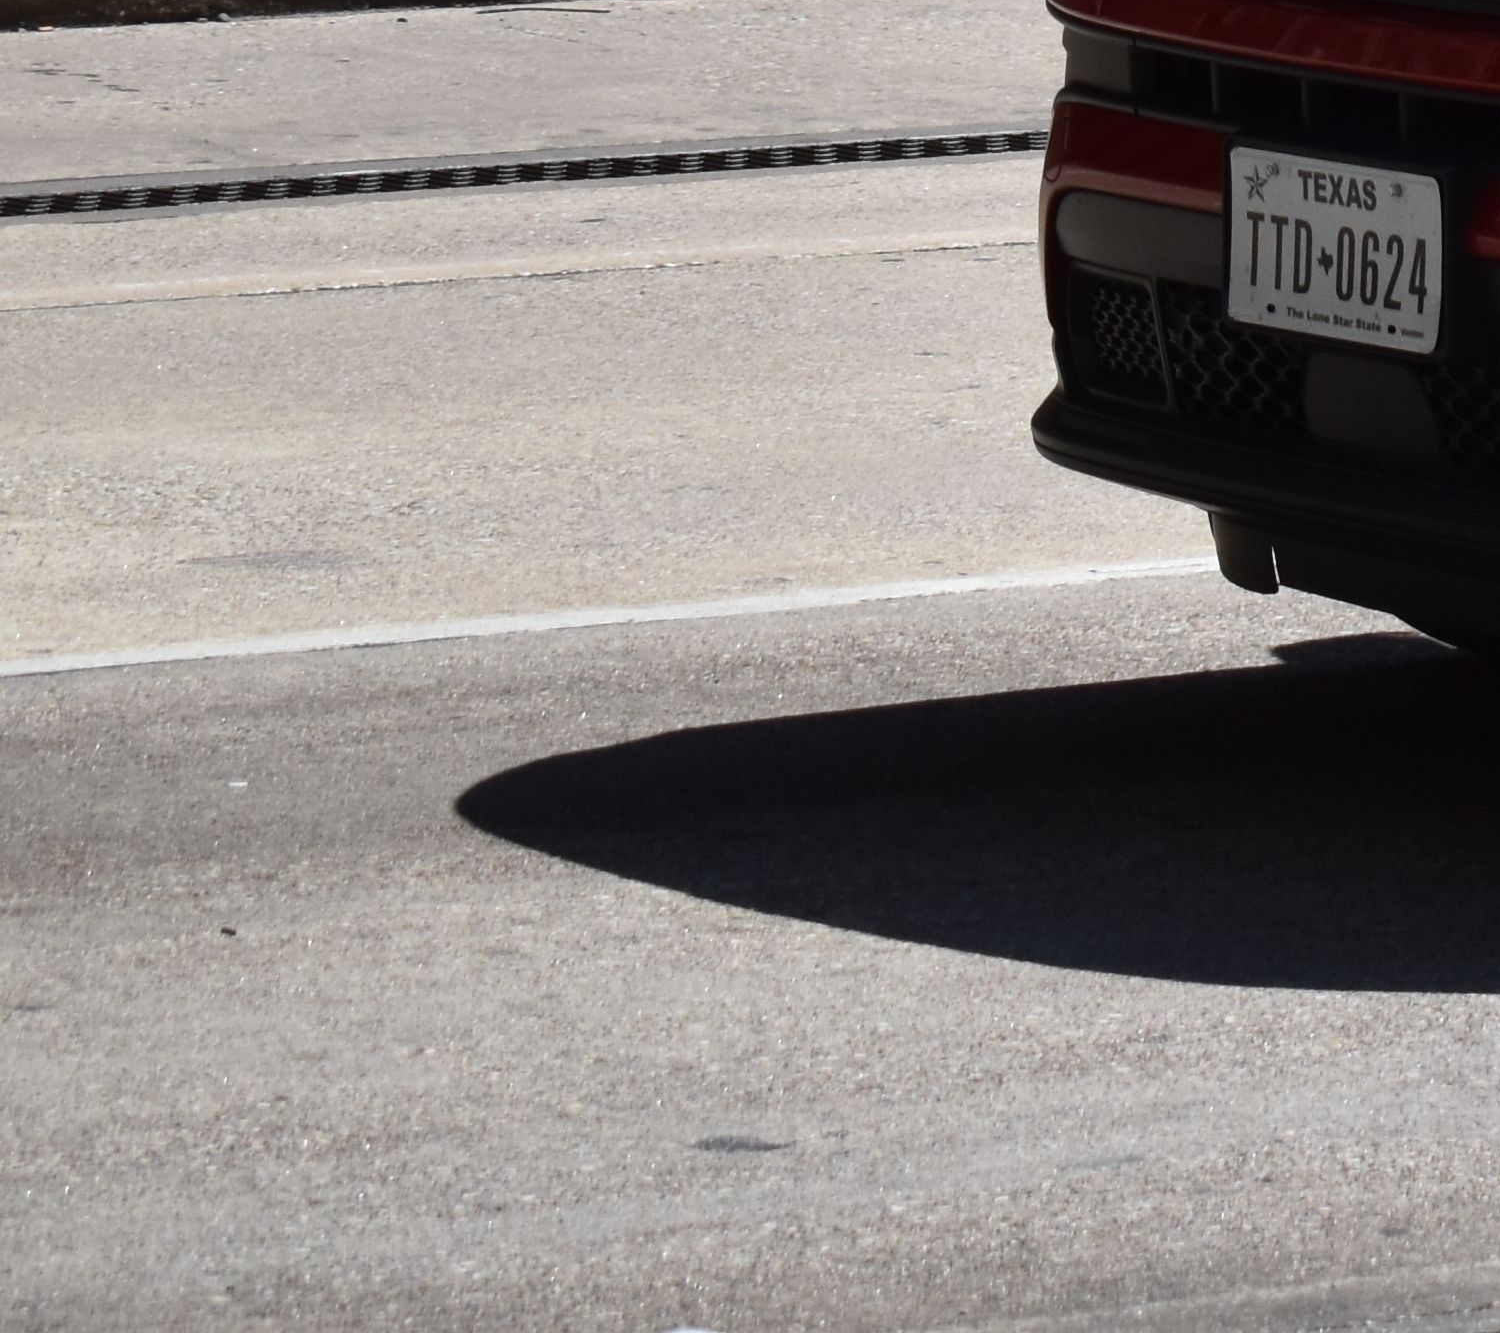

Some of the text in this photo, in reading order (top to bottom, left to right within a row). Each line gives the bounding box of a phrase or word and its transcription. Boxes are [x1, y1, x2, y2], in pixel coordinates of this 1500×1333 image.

[1298, 169, 1377, 211] TEXAS
[1286, 307, 1381, 333] The Lone Star State
